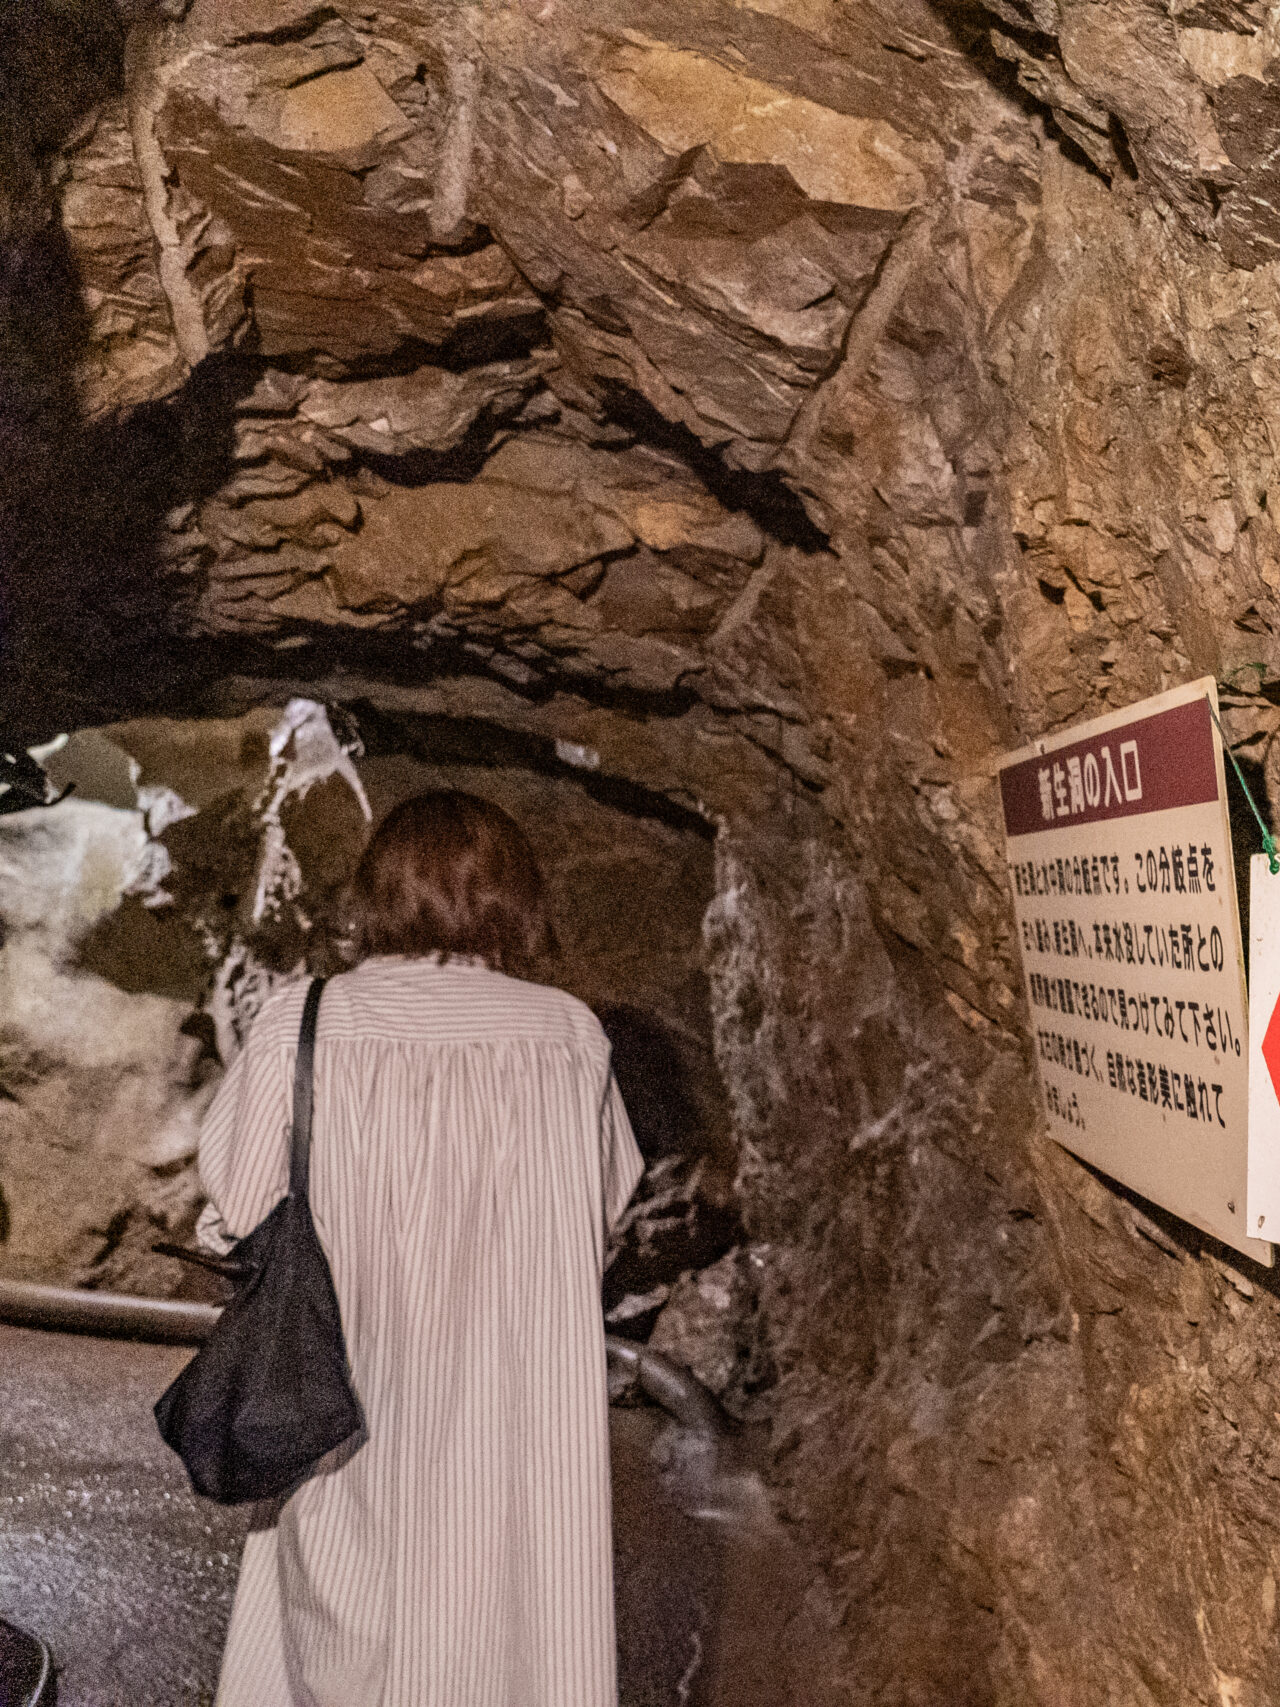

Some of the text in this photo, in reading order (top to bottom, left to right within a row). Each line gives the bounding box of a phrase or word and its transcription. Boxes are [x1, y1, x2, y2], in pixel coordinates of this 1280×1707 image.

[1038, 739, 1142, 821] 新生洞の入口
